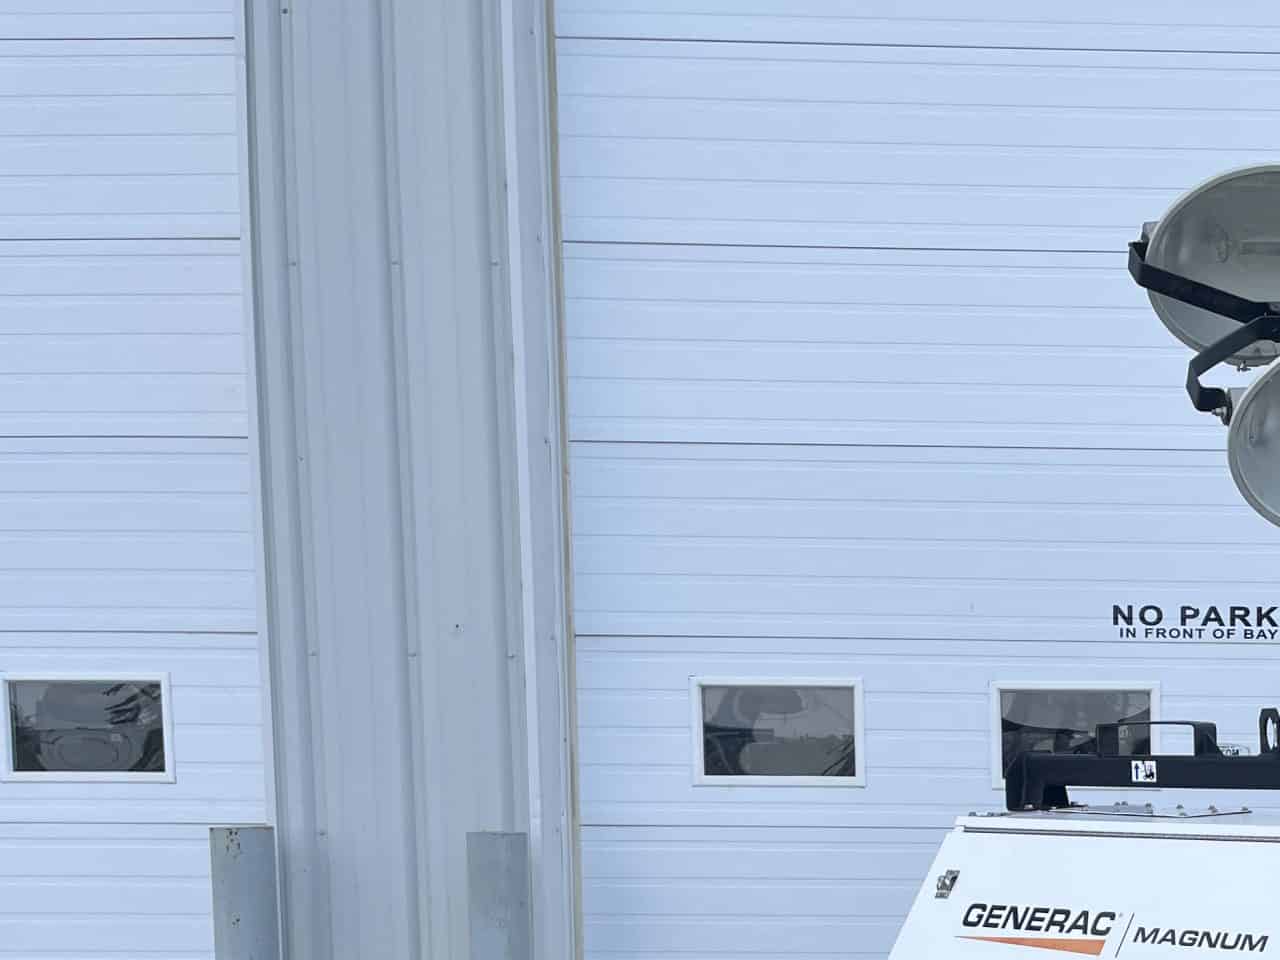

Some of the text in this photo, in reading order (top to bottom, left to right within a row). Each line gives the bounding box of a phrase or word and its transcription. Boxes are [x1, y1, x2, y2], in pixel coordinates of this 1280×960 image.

[1112, 604, 1163, 626] NO
[1119, 627, 1136, 638] IN
[1144, 627, 1205, 639] FRONT
[1212, 628, 1236, 639] OF
[1243, 629, 1278, 640] BAY
[962, 903, 1269, 952] GENERAC MAGNUM
